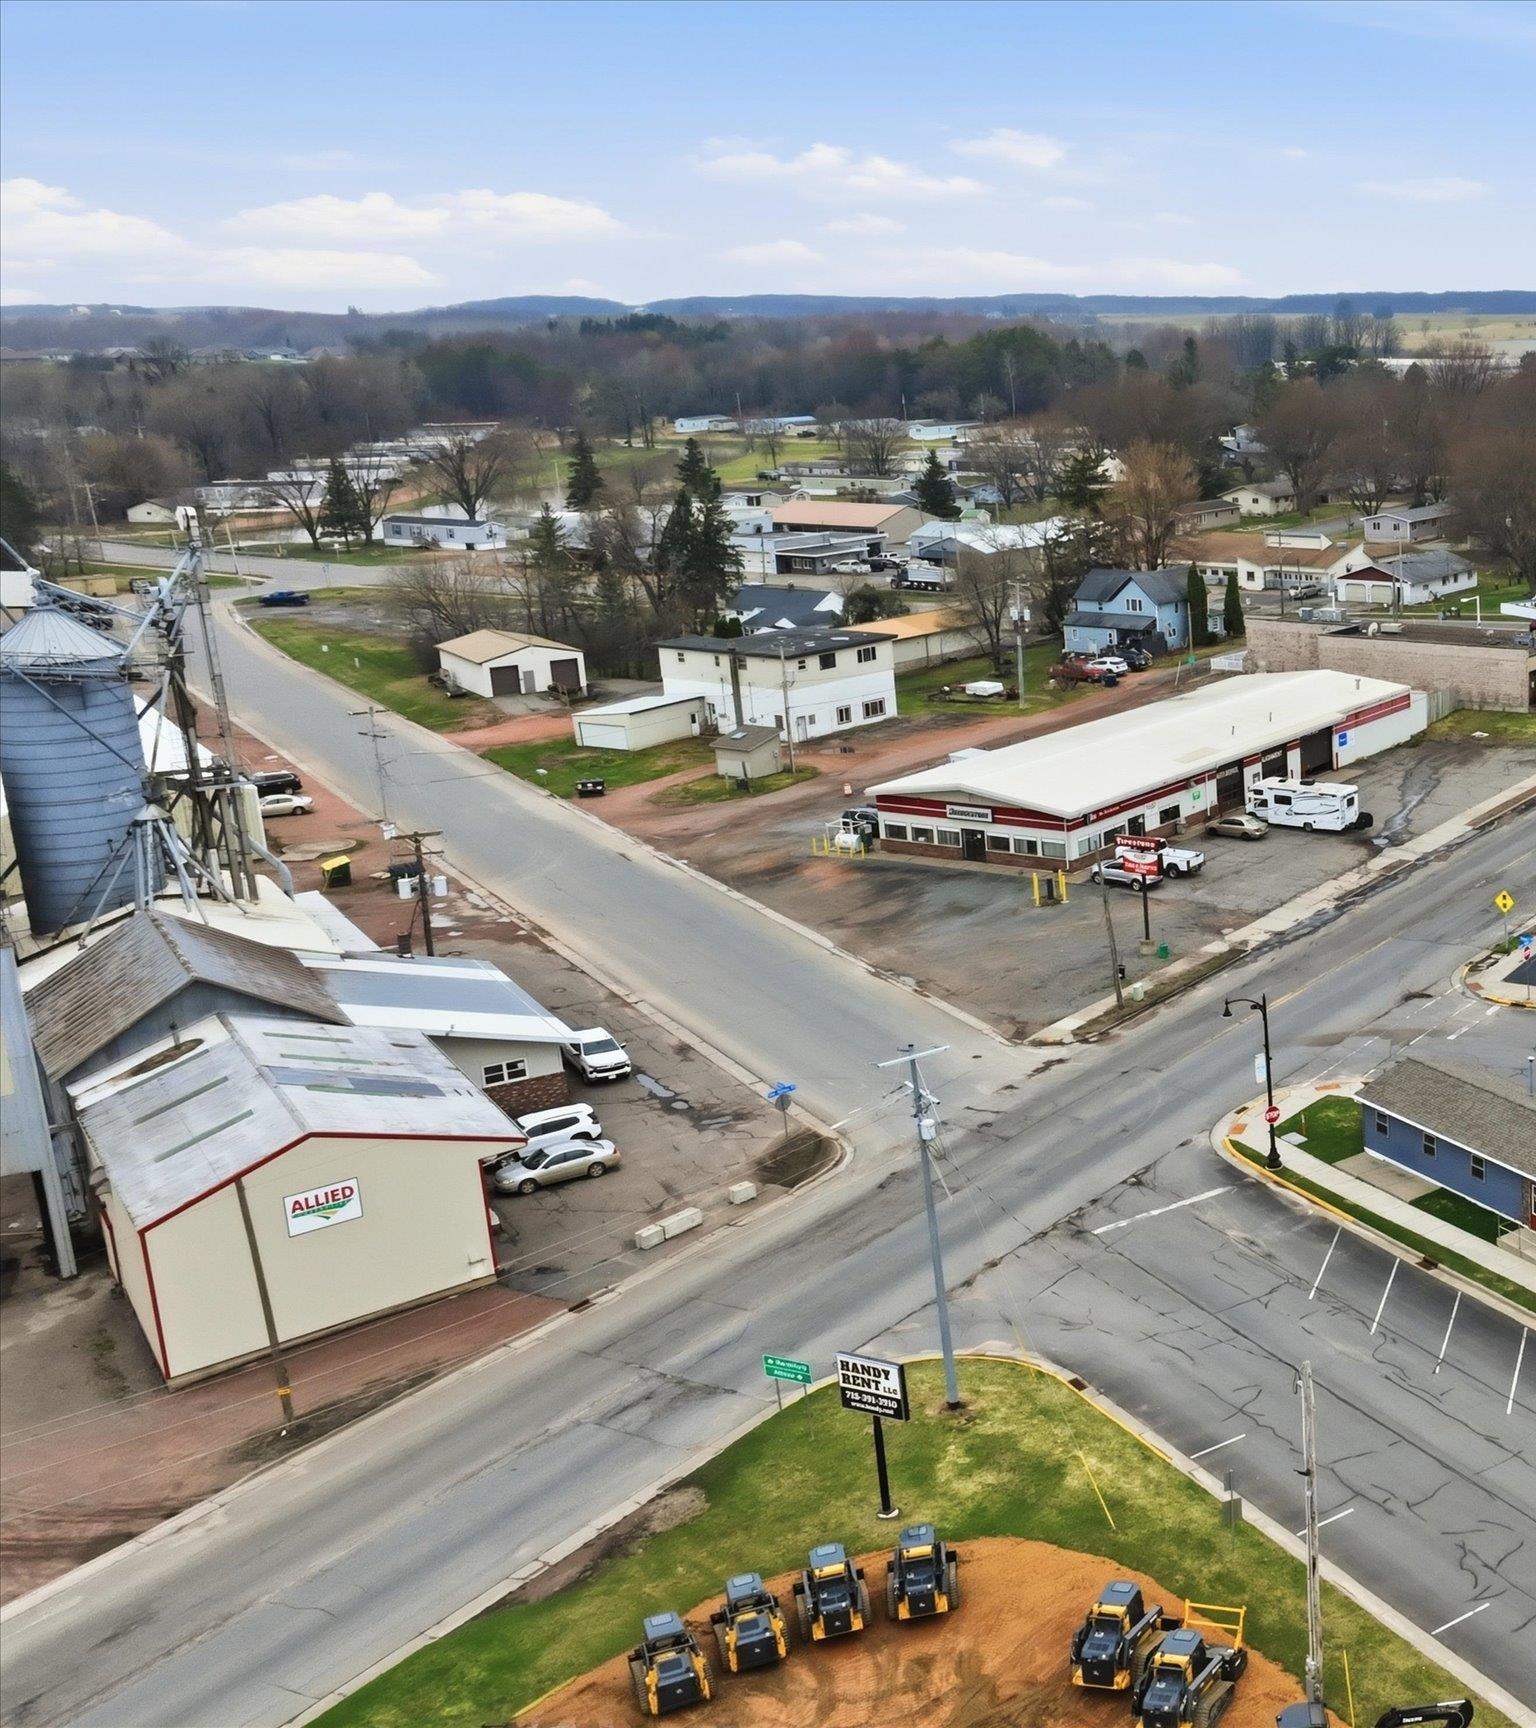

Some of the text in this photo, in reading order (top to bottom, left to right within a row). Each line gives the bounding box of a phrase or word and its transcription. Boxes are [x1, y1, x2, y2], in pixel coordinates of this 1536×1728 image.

[292, 1186, 354, 1214] ALLIED
[839, 1360, 891, 1380] HANDY
[841, 1372, 898, 1396] RENT LLC
